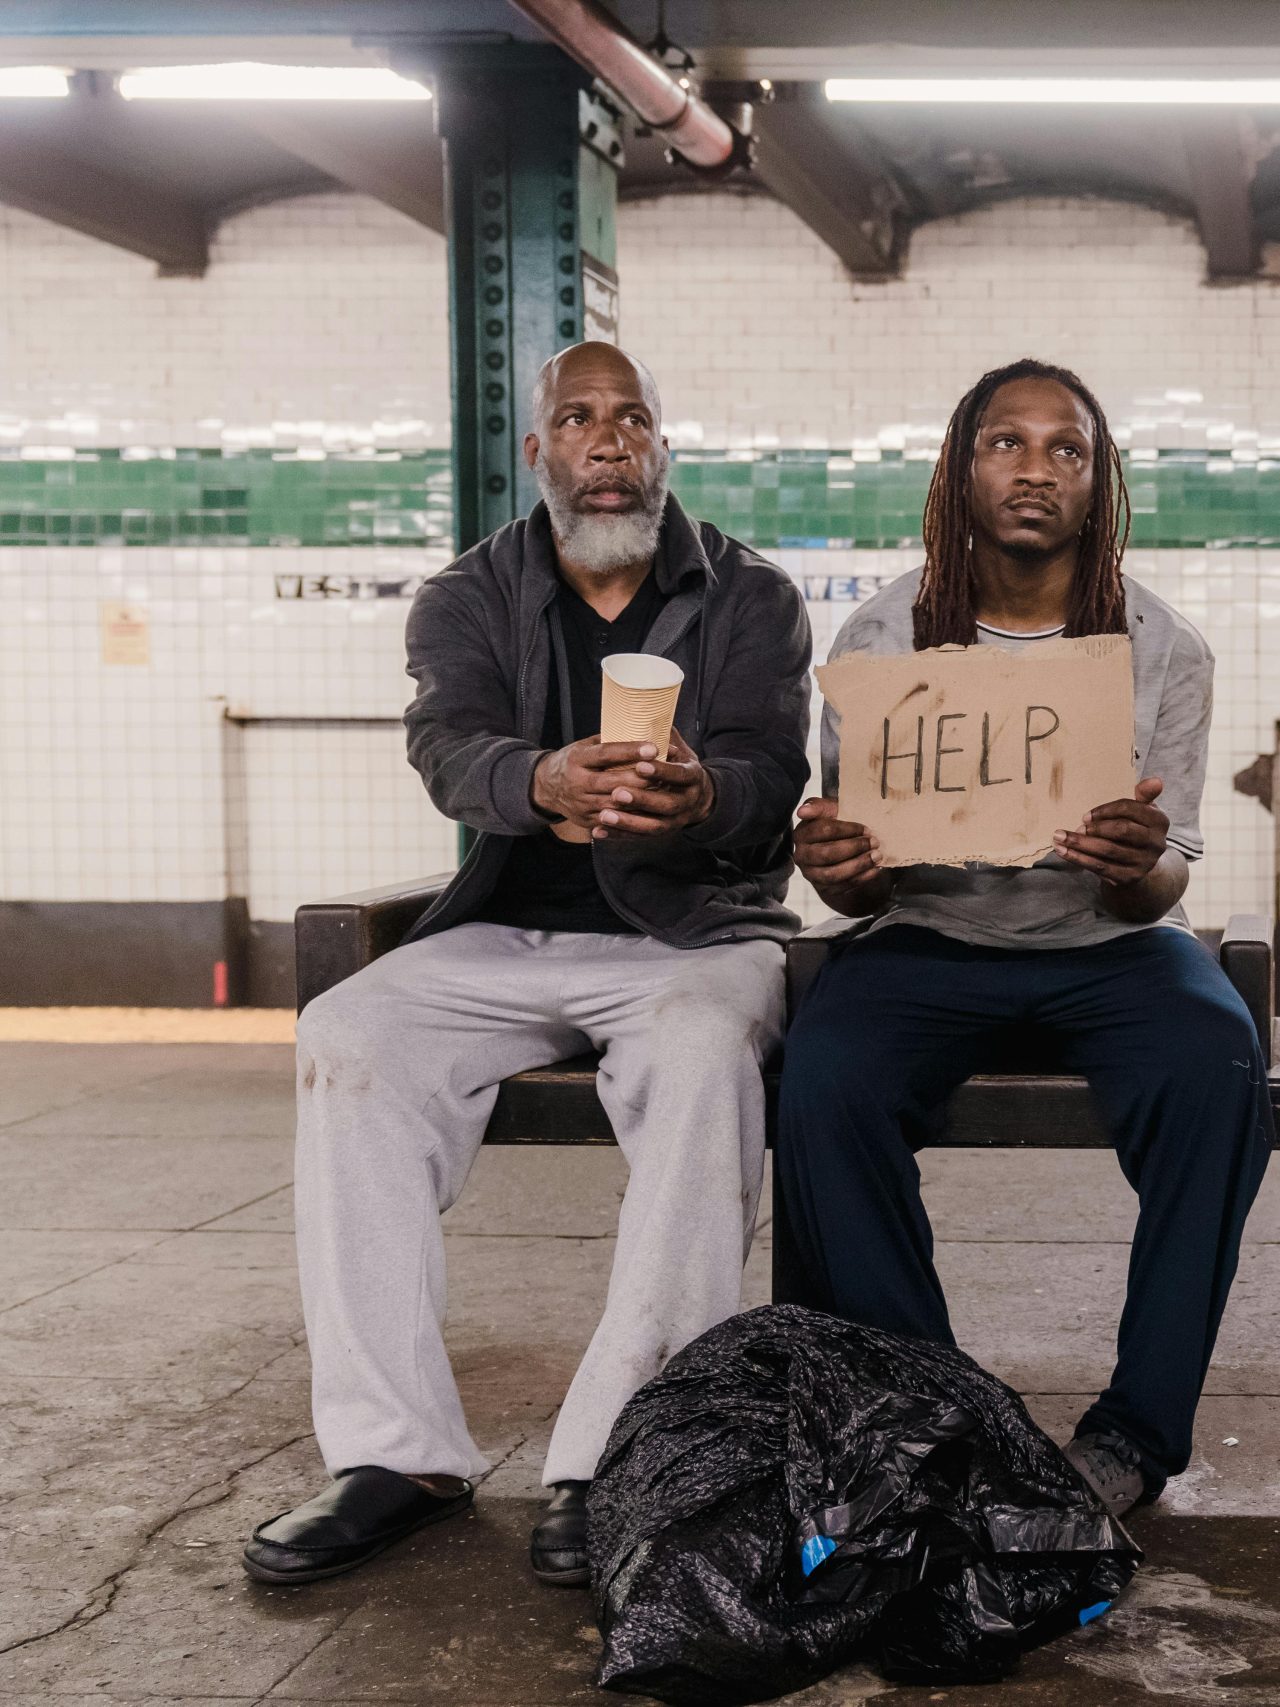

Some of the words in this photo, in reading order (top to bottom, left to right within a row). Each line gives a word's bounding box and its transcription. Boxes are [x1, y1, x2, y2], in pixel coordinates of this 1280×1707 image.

[275, 575, 374, 598] WEST
[804, 576, 887, 600] WES
[881, 705, 1060, 800] HELP
